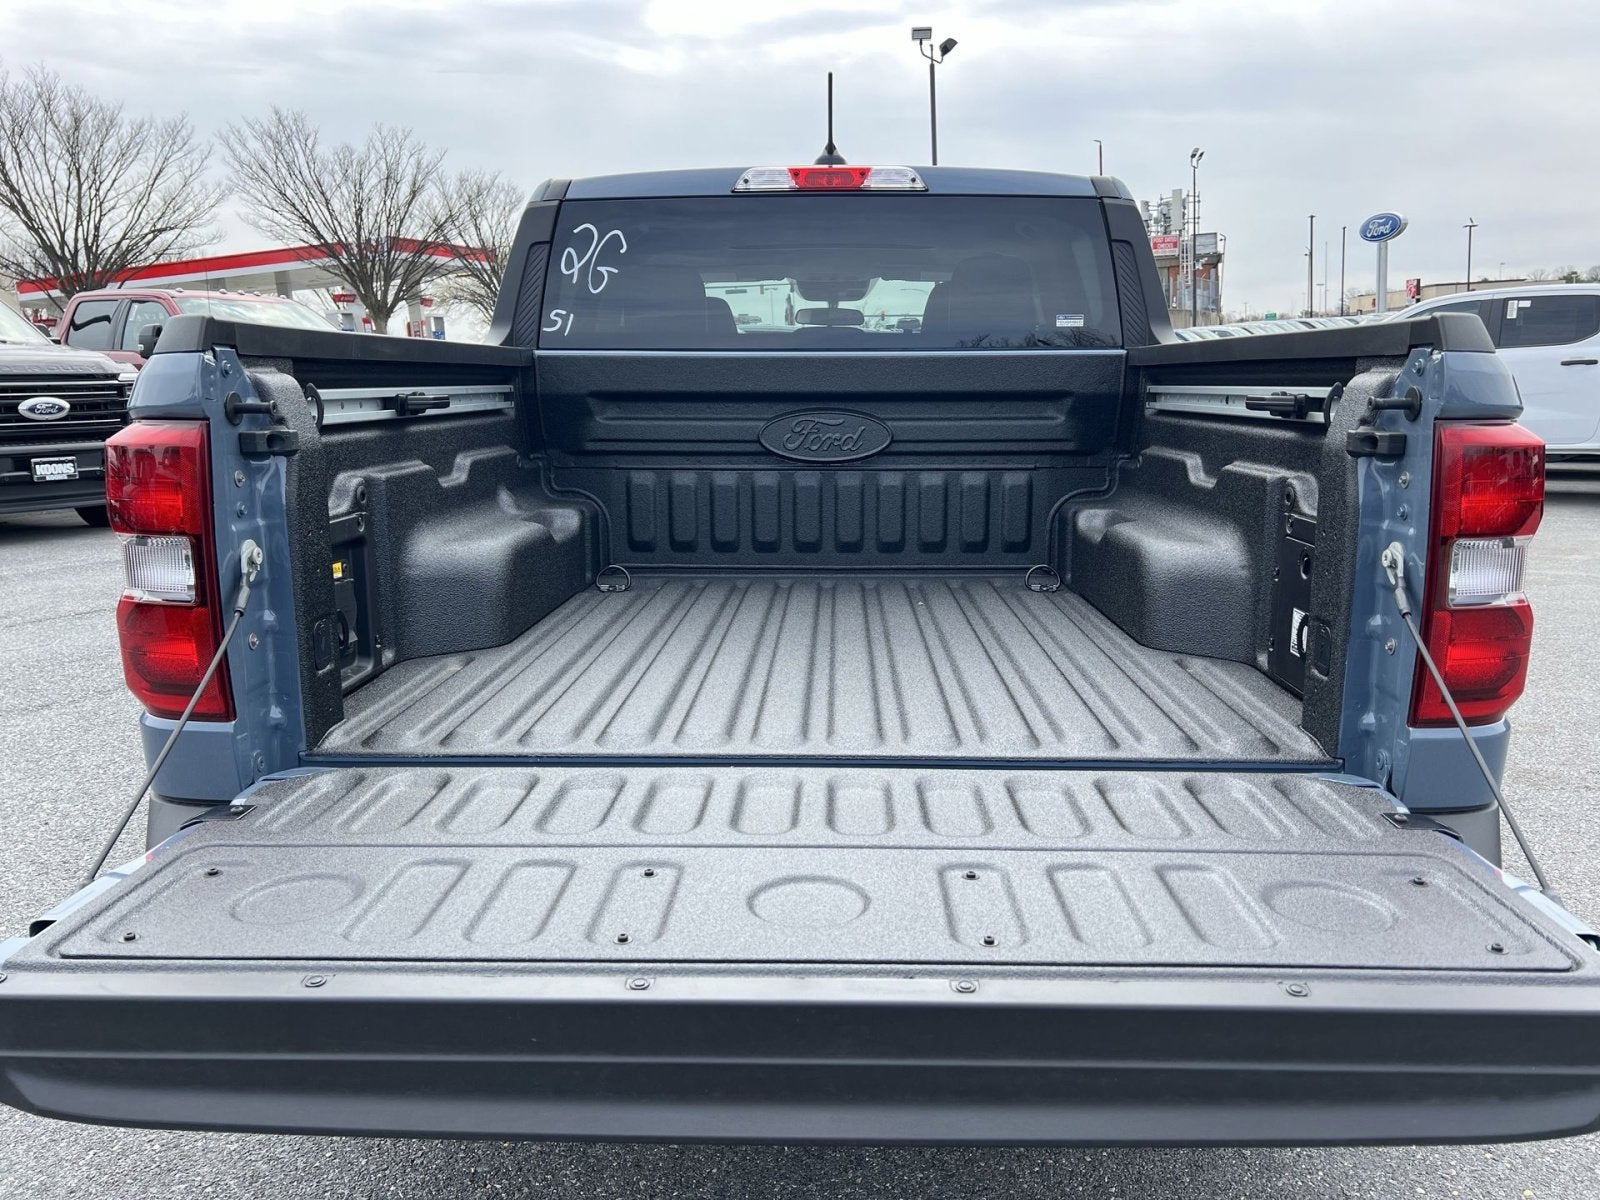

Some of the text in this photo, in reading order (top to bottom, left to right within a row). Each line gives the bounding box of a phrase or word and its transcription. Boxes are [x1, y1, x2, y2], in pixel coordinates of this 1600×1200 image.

[1366, 217, 1392, 237] Ford
[34, 403, 59, 414] Ford
[783, 417, 866, 451] Ford
[35, 462, 75, 475] KOONS
